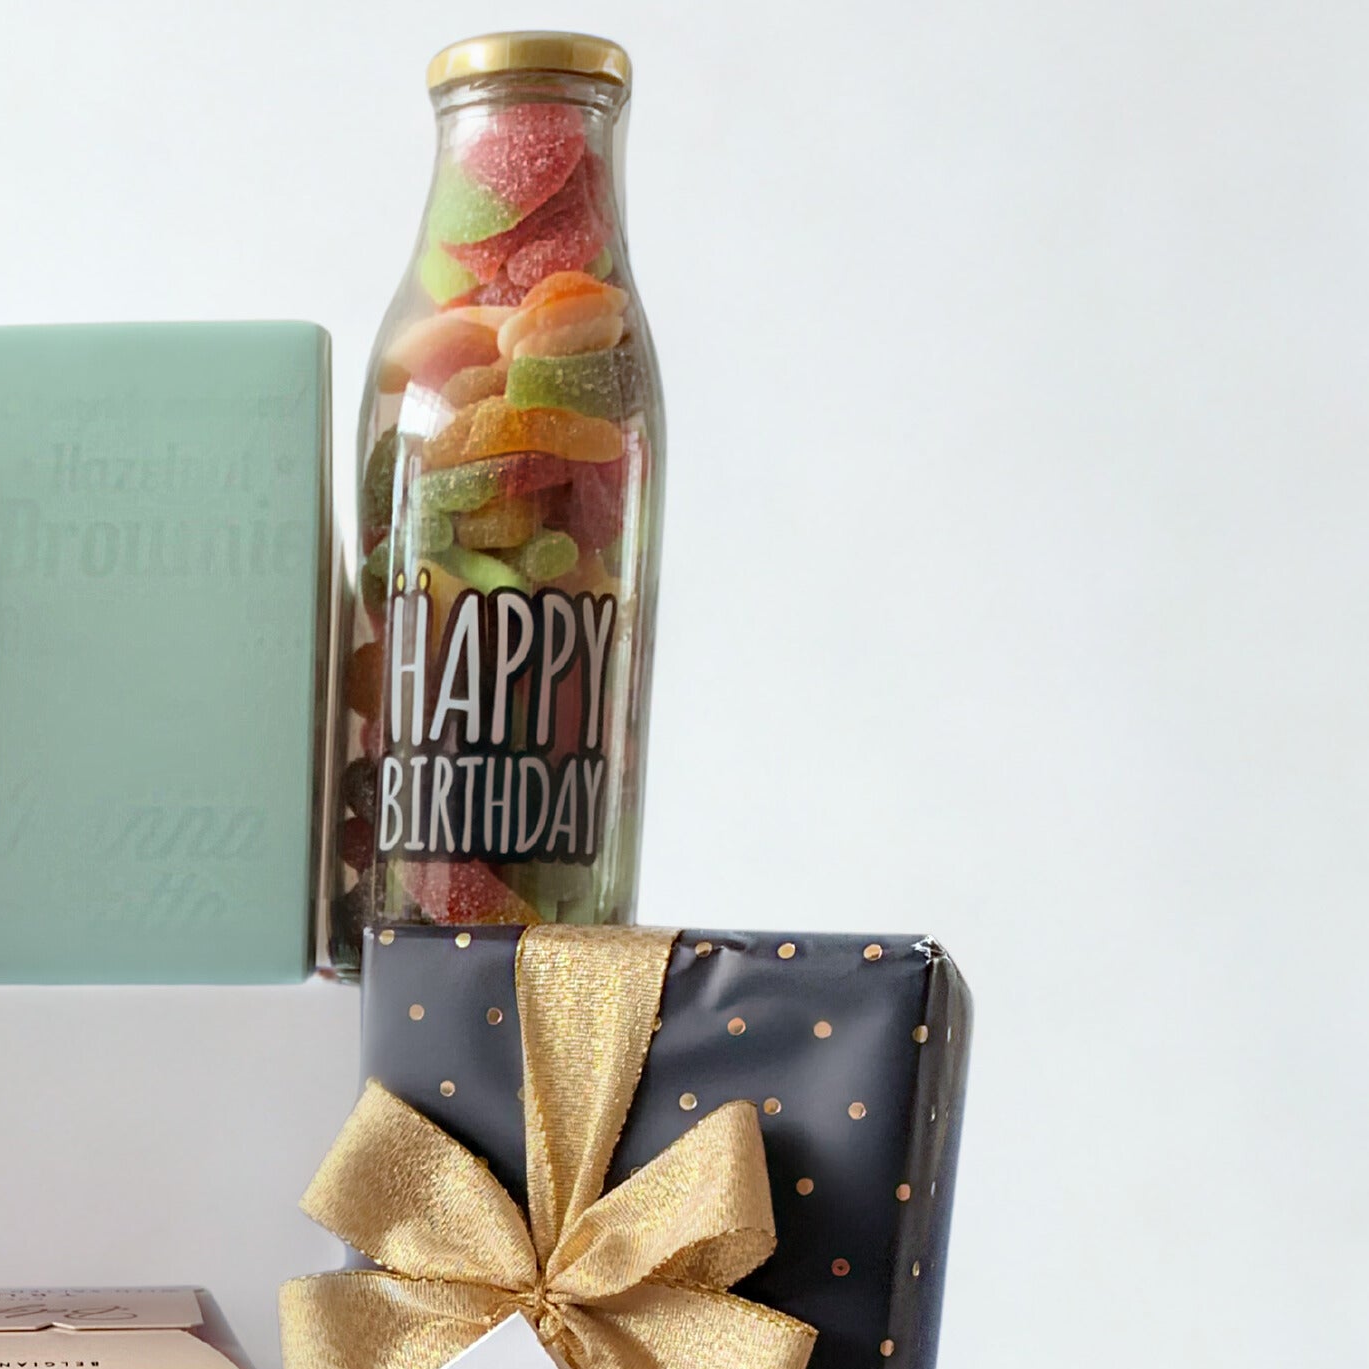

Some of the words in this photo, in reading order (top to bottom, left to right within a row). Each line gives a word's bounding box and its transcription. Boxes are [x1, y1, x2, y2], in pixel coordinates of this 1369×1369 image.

[390, 594, 615, 749] HAPPY
[379, 755, 604, 855] BIRTHDAY
[0, 1361, 99, 1369] BELGIAN
